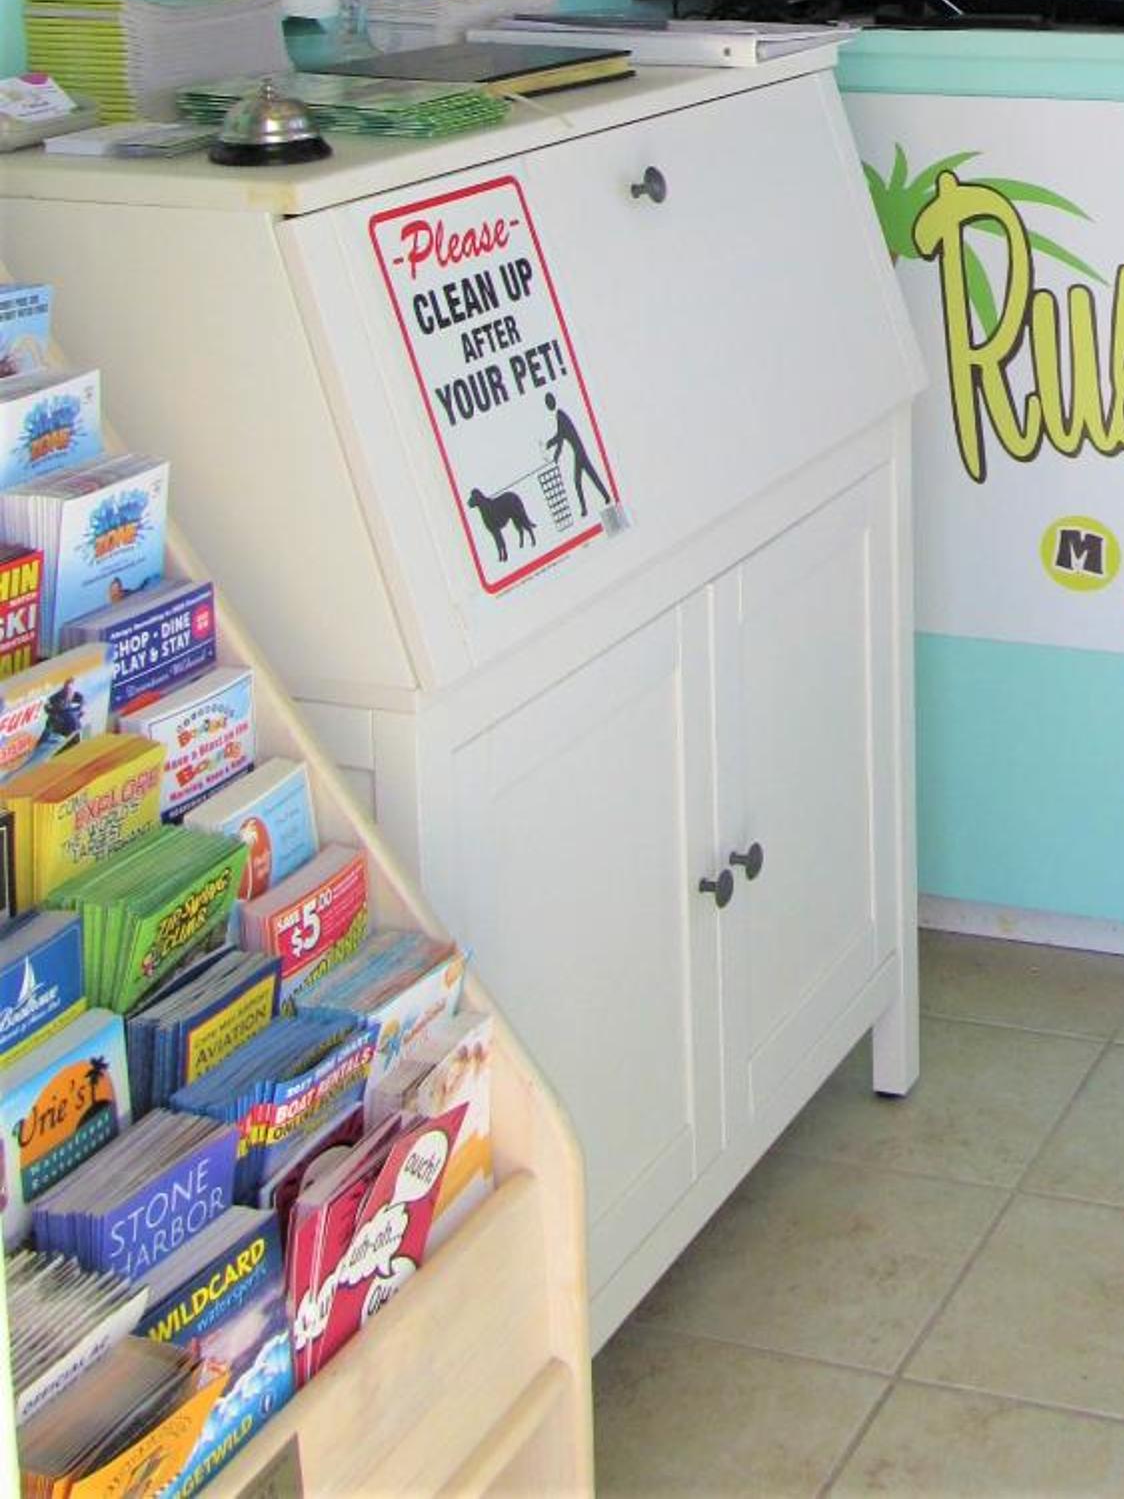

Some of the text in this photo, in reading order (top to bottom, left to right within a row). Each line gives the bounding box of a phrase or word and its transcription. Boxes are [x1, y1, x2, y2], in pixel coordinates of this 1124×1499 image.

[413, 257, 533, 335] CLEAN UP
[461, 314, 521, 363] AFTER
[435, 338, 568, 427] YOUR PET!
[113, 611, 191, 660] SHOP DINE
[113, 650, 147, 680] PLAY
[161, 630, 191, 658] STAY
[12, 1077, 86, 1148] Urie's
[111, 1158, 209, 1257] STONE
[147, 1238, 265, 1343] WILDCARD
